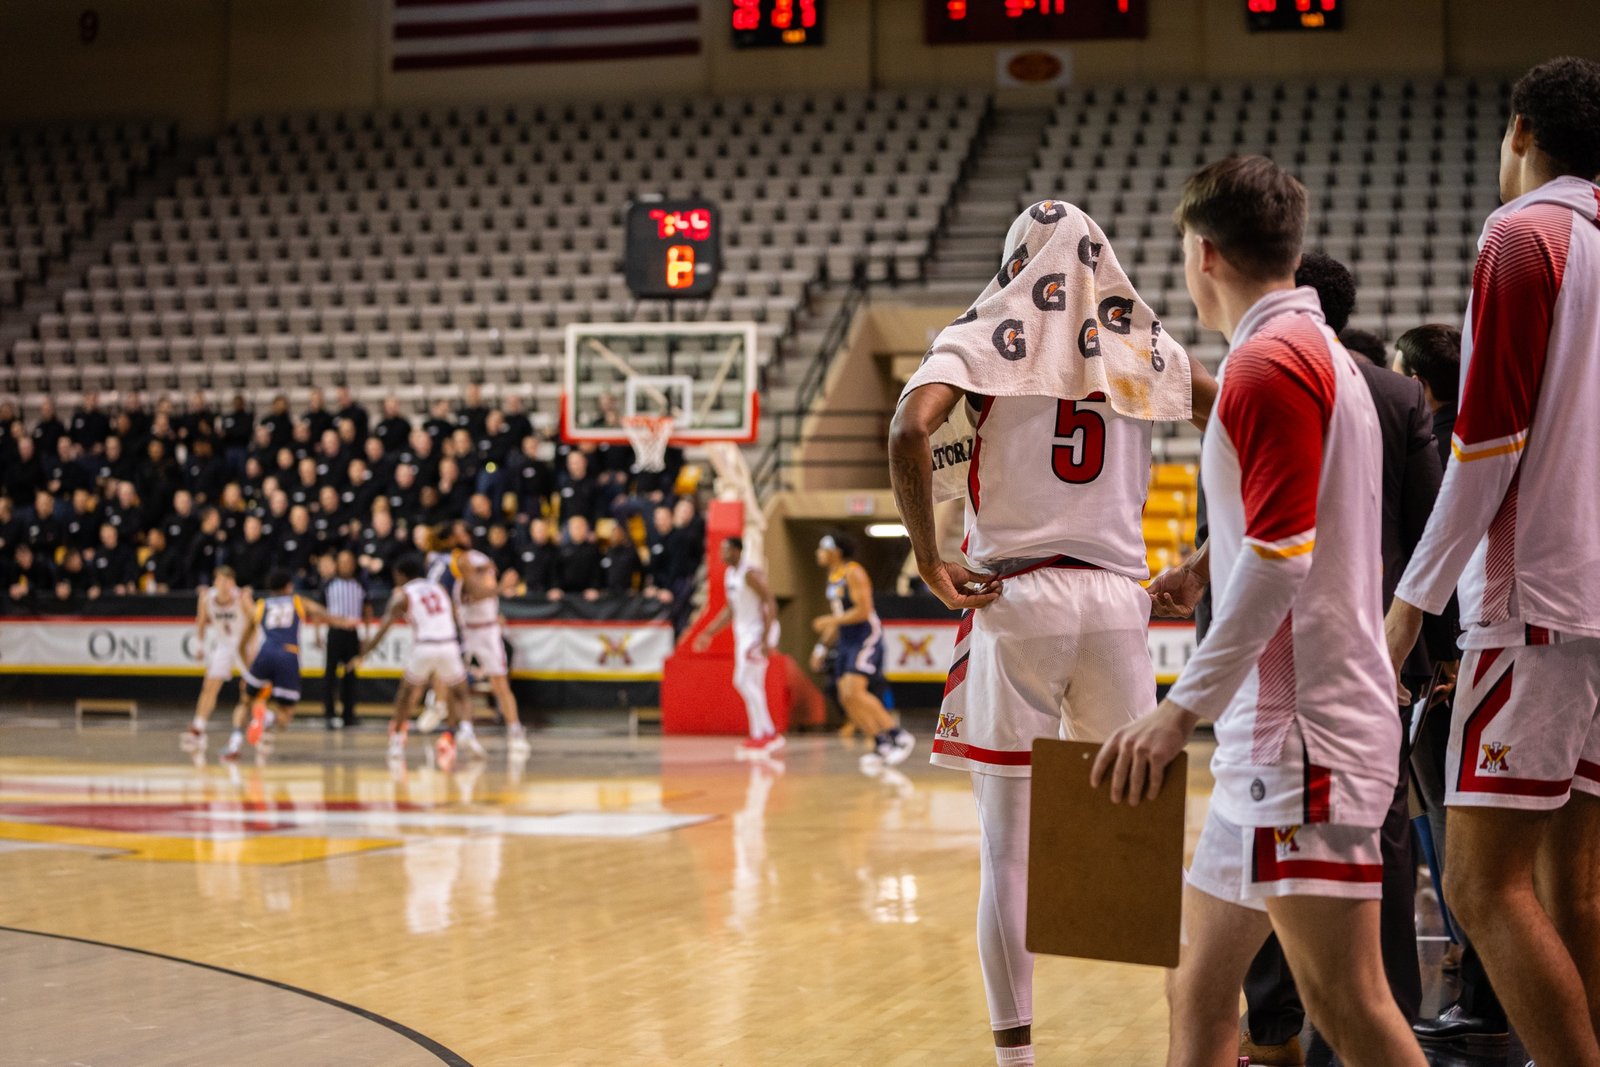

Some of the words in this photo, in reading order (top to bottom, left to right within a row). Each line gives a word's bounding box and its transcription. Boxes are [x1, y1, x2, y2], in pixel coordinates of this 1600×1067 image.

[1032, 273, 1067, 311] G
[1098, 296, 1136, 335] G
[992, 319, 1027, 361] G
[1051, 392, 1106, 485] 5
